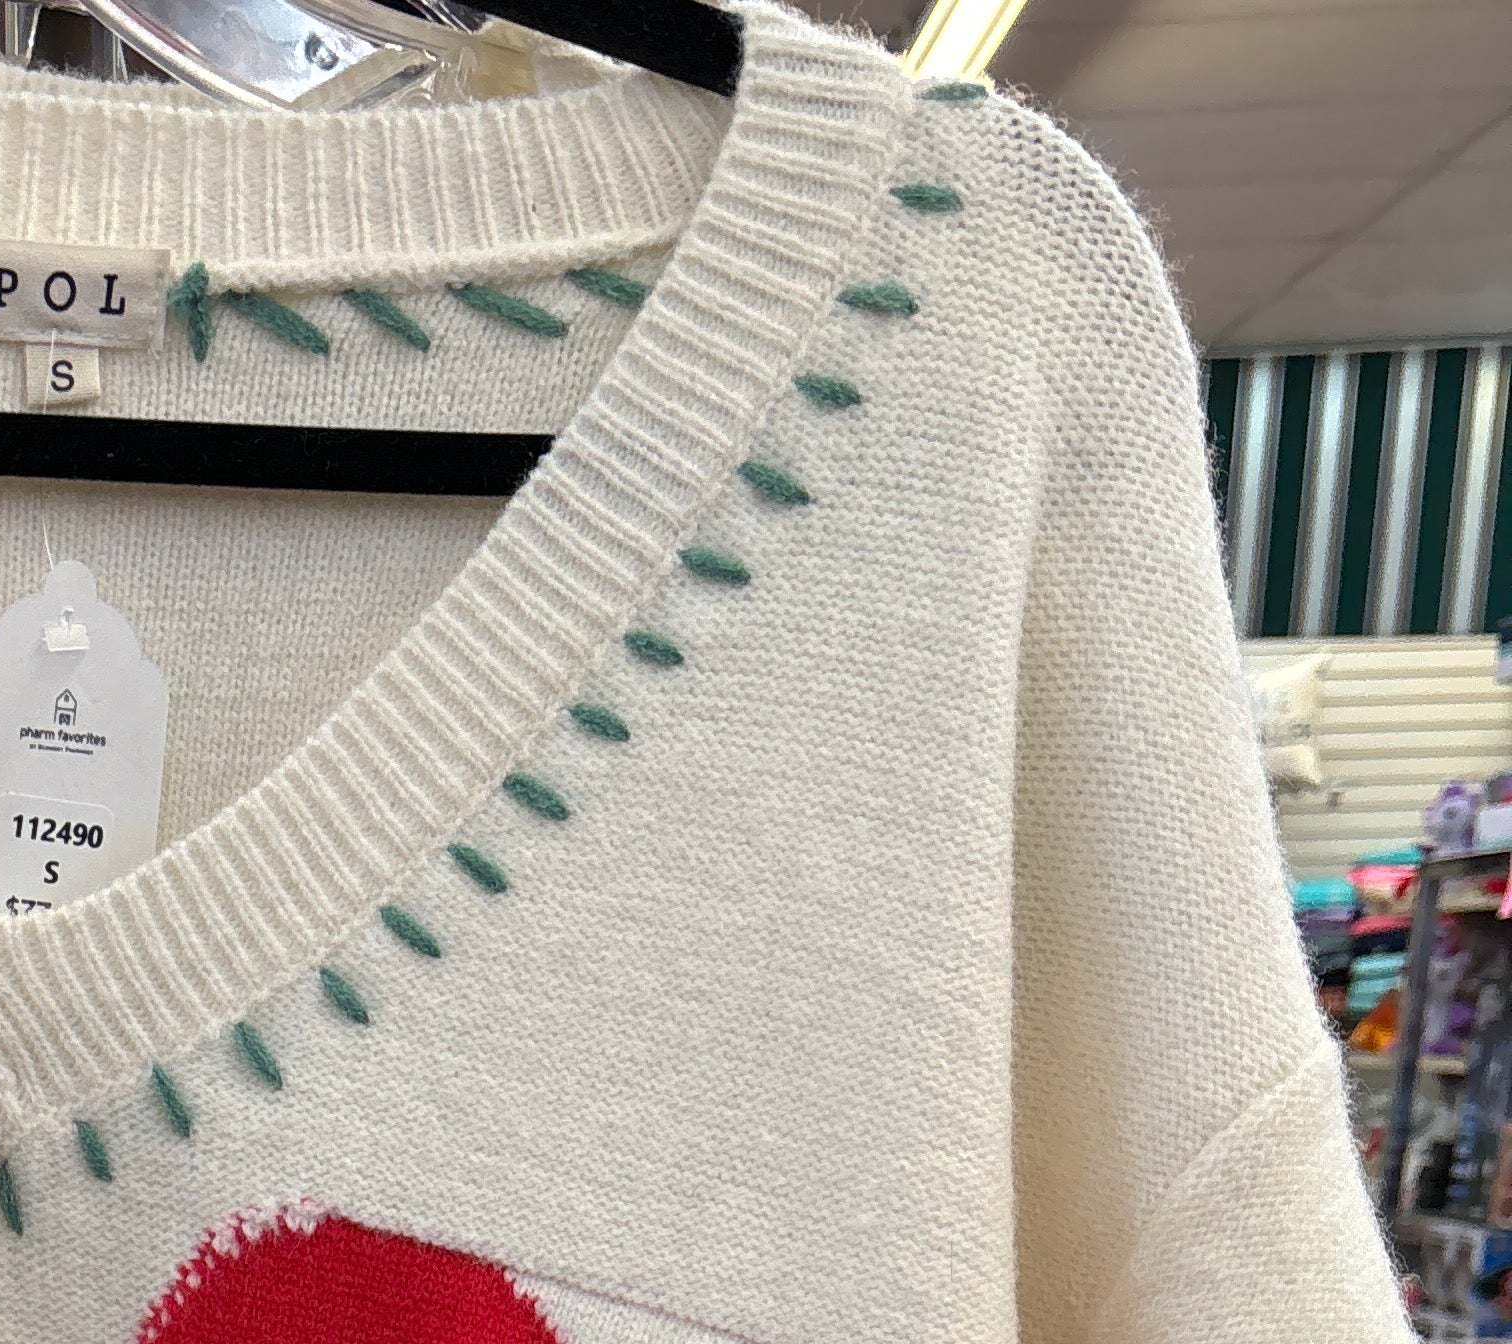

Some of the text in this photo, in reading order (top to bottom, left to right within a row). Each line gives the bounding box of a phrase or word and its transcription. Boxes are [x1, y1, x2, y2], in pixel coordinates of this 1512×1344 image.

[50, 359, 76, 392] S
[19, 726, 107, 747] pharm favorites
[12, 814, 104, 849] 112490
[43, 860, 60, 884] S
